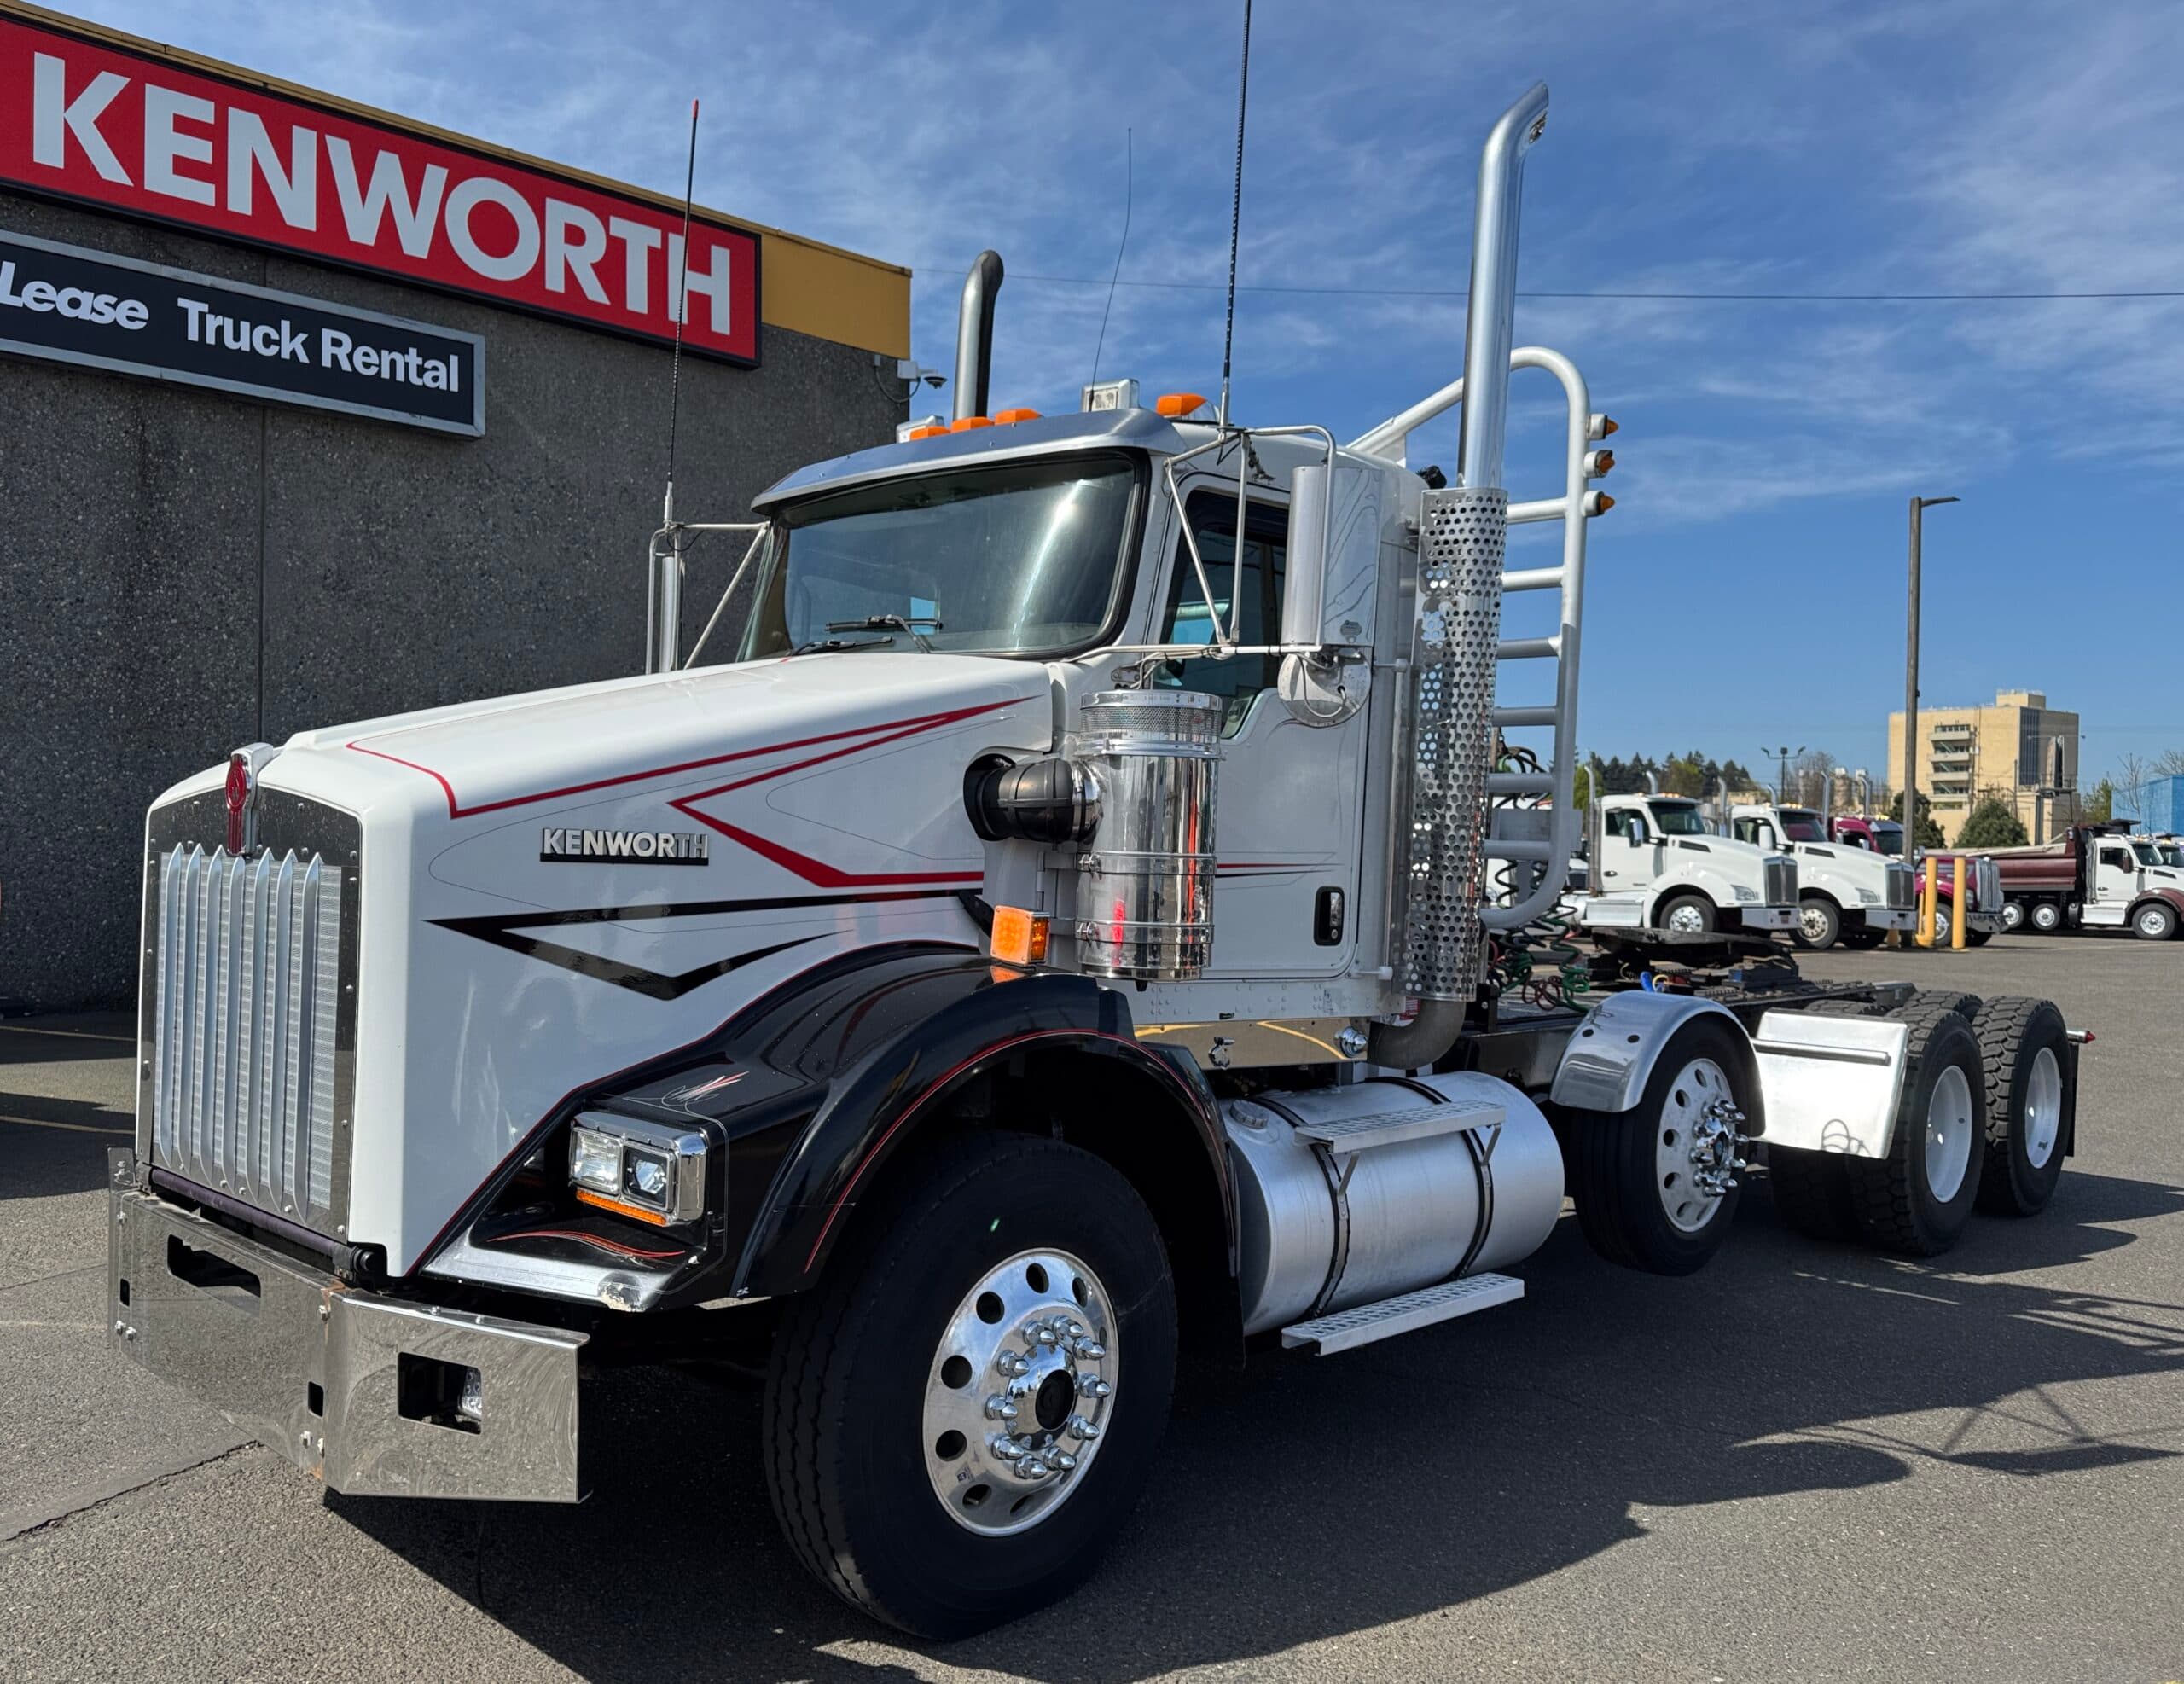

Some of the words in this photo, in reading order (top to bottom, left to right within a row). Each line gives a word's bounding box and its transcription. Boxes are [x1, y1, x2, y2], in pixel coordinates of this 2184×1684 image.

[33, 52, 731, 336] KENWORTH
[0, 260, 149, 330] Lease
[177, 297, 310, 364] Truck
[321, 328, 459, 392] Rental
[543, 827, 709, 858] KENWORTH
